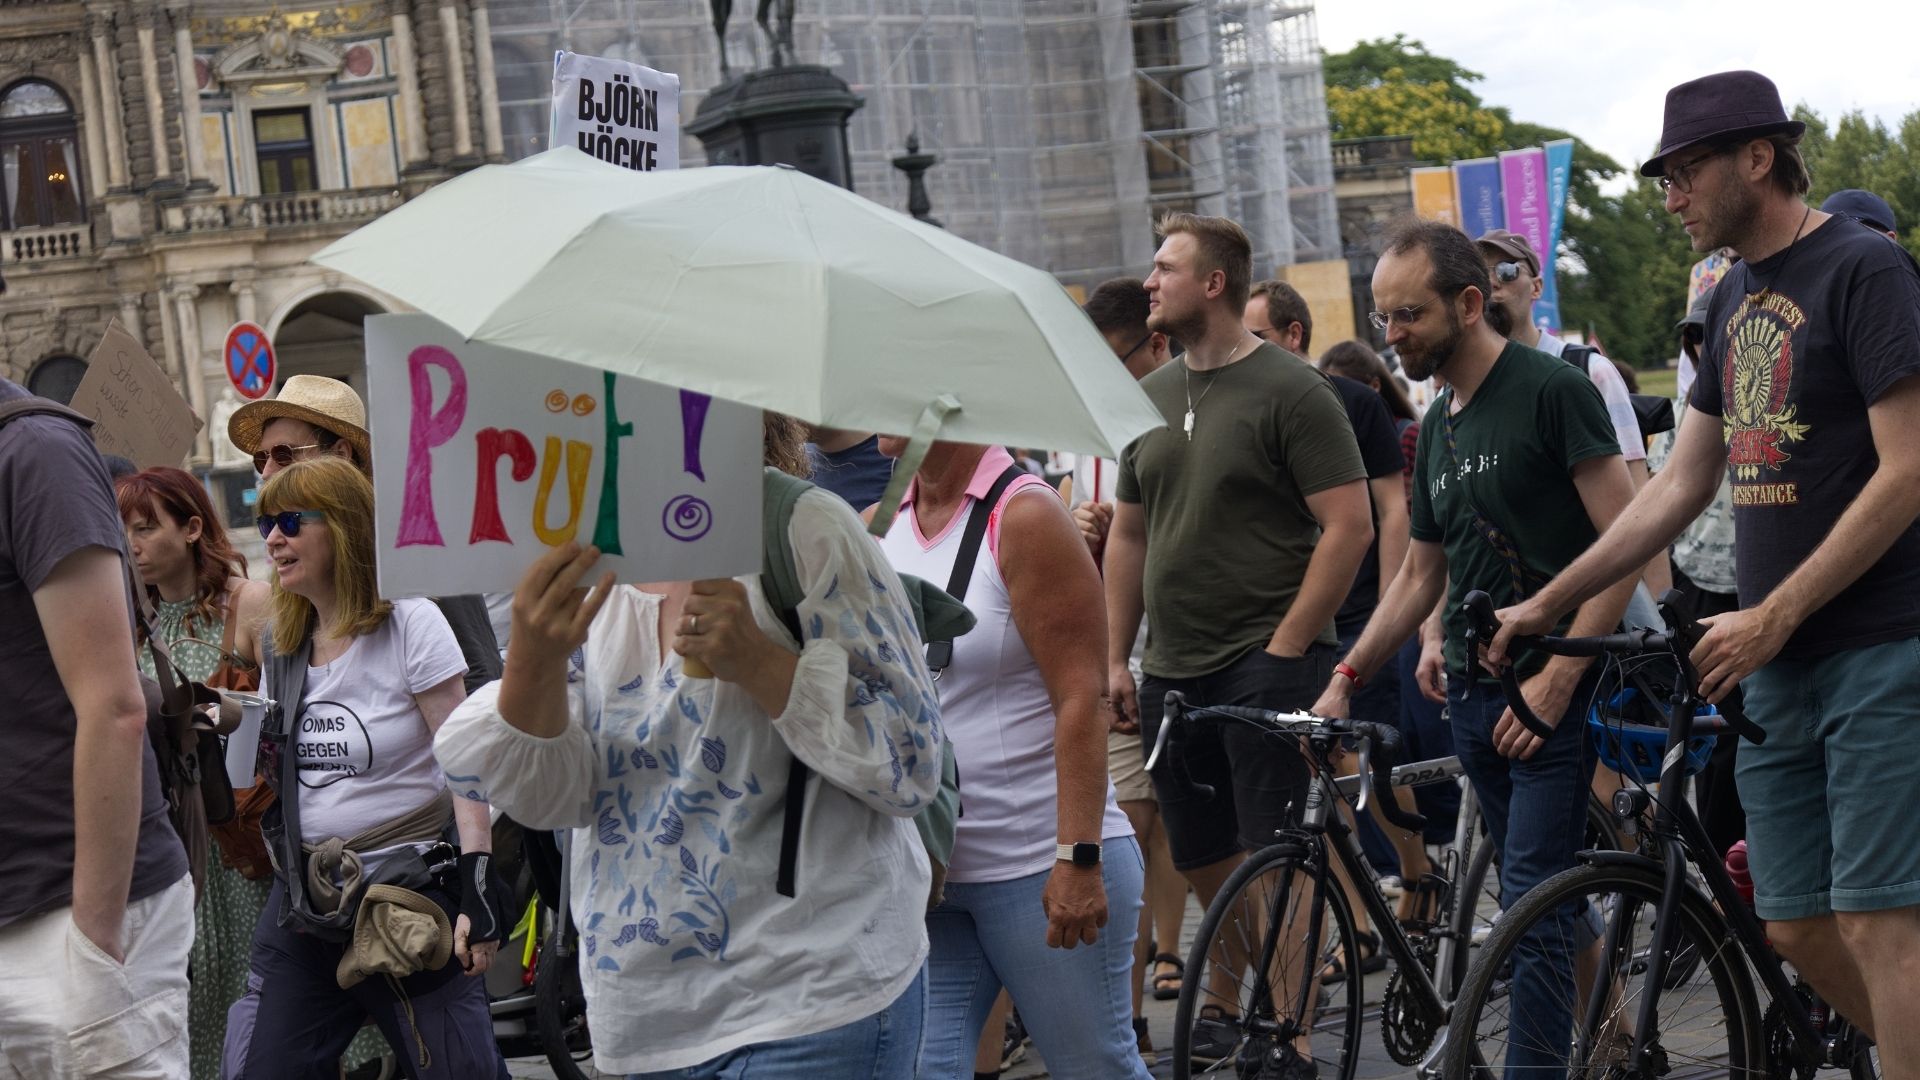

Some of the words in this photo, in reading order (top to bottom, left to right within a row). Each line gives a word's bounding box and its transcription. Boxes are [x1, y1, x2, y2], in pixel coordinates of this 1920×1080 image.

[578, 74, 659, 132] BJÖRN
[302, 716, 345, 733] OMAS
[295, 741, 349, 758] GEGEN
